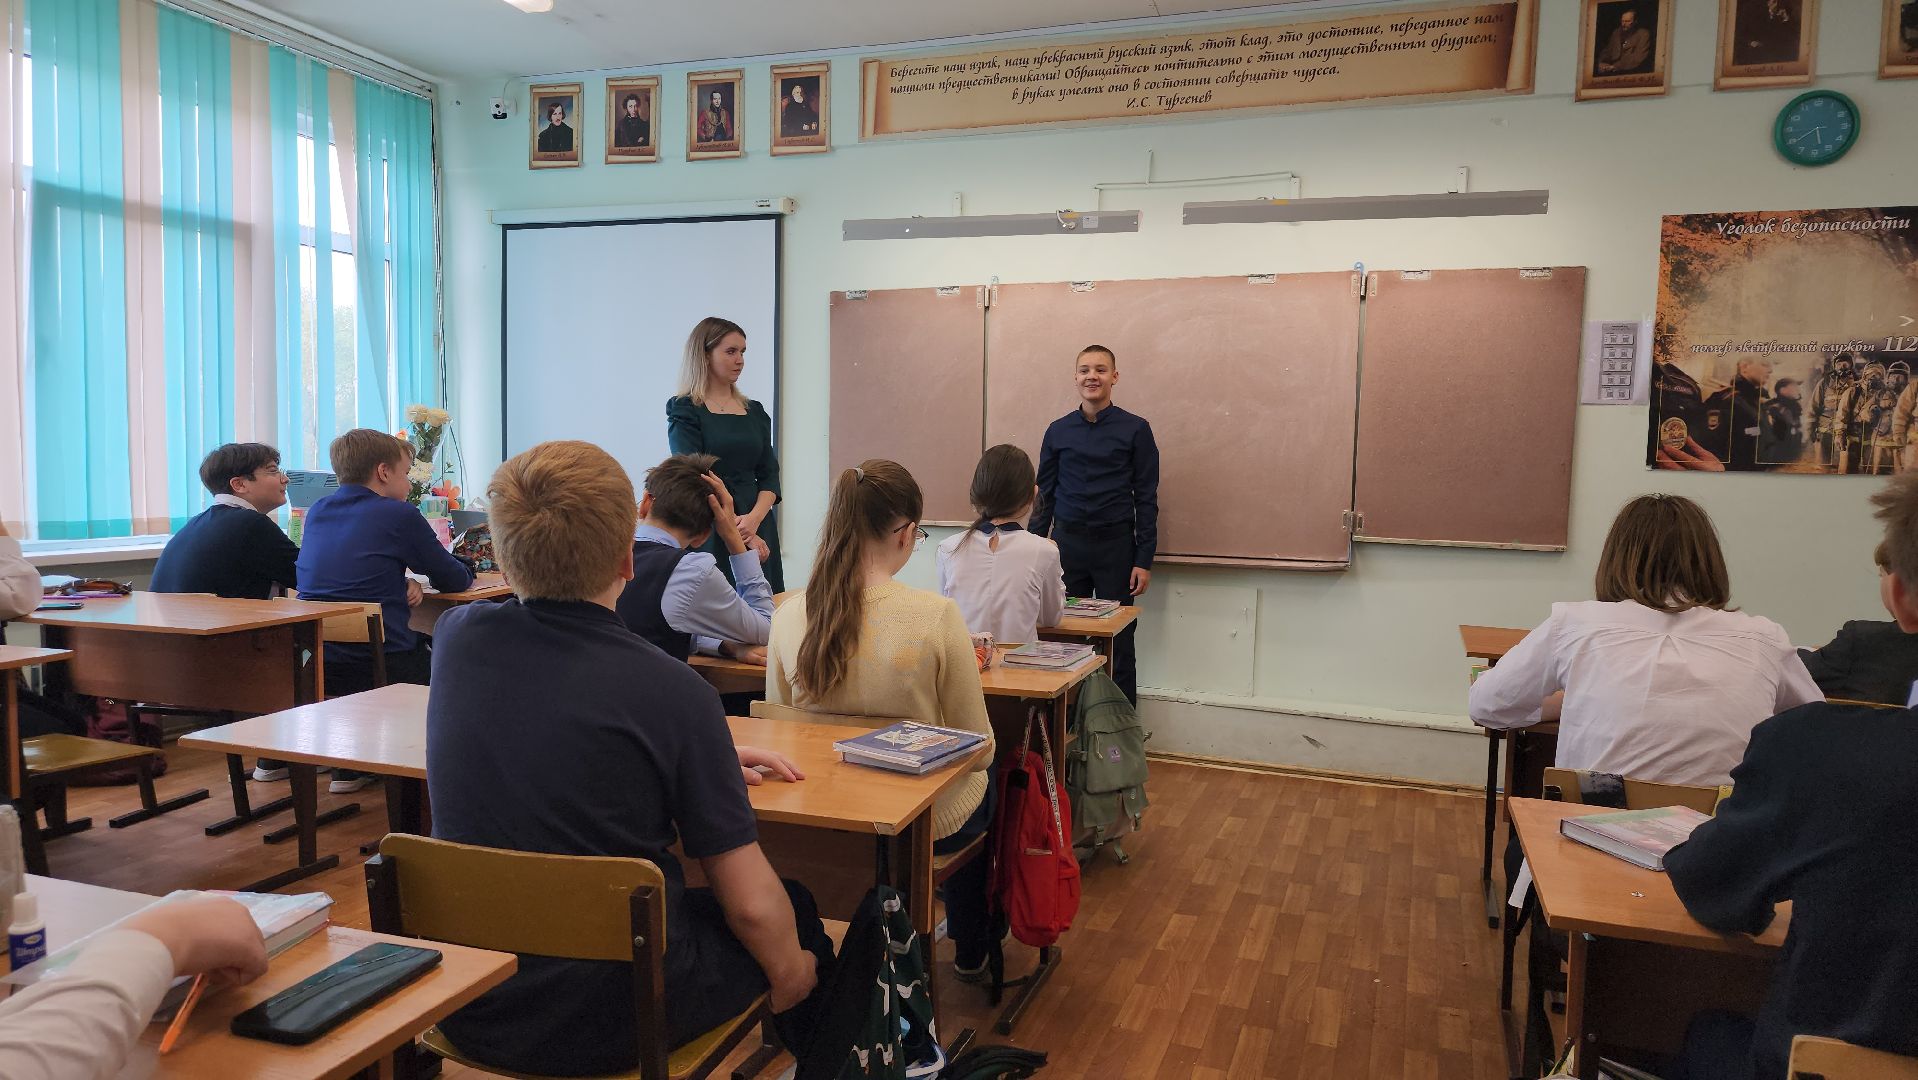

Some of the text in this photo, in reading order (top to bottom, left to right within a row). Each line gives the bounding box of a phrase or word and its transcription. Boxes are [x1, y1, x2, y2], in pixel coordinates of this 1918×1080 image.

[890, 12, 1505, 81] Берегите наш язык, наш прекрасный русский язык, этот клад, это достояние, переданное нам
[890, 32, 1497, 95] нашими предшественниками! Обращайтесь почтительно с этим могущественным орудием;
[1012, 65, 1341, 104] в руках умелых оно в состоянии совершать чудеса.
[1126, 90, 1212, 110] И.С. Тургенев
[1716, 216, 1911, 239] Уголок безопасности
[1691, 336, 1918, 357] номер экстренной службы 112
